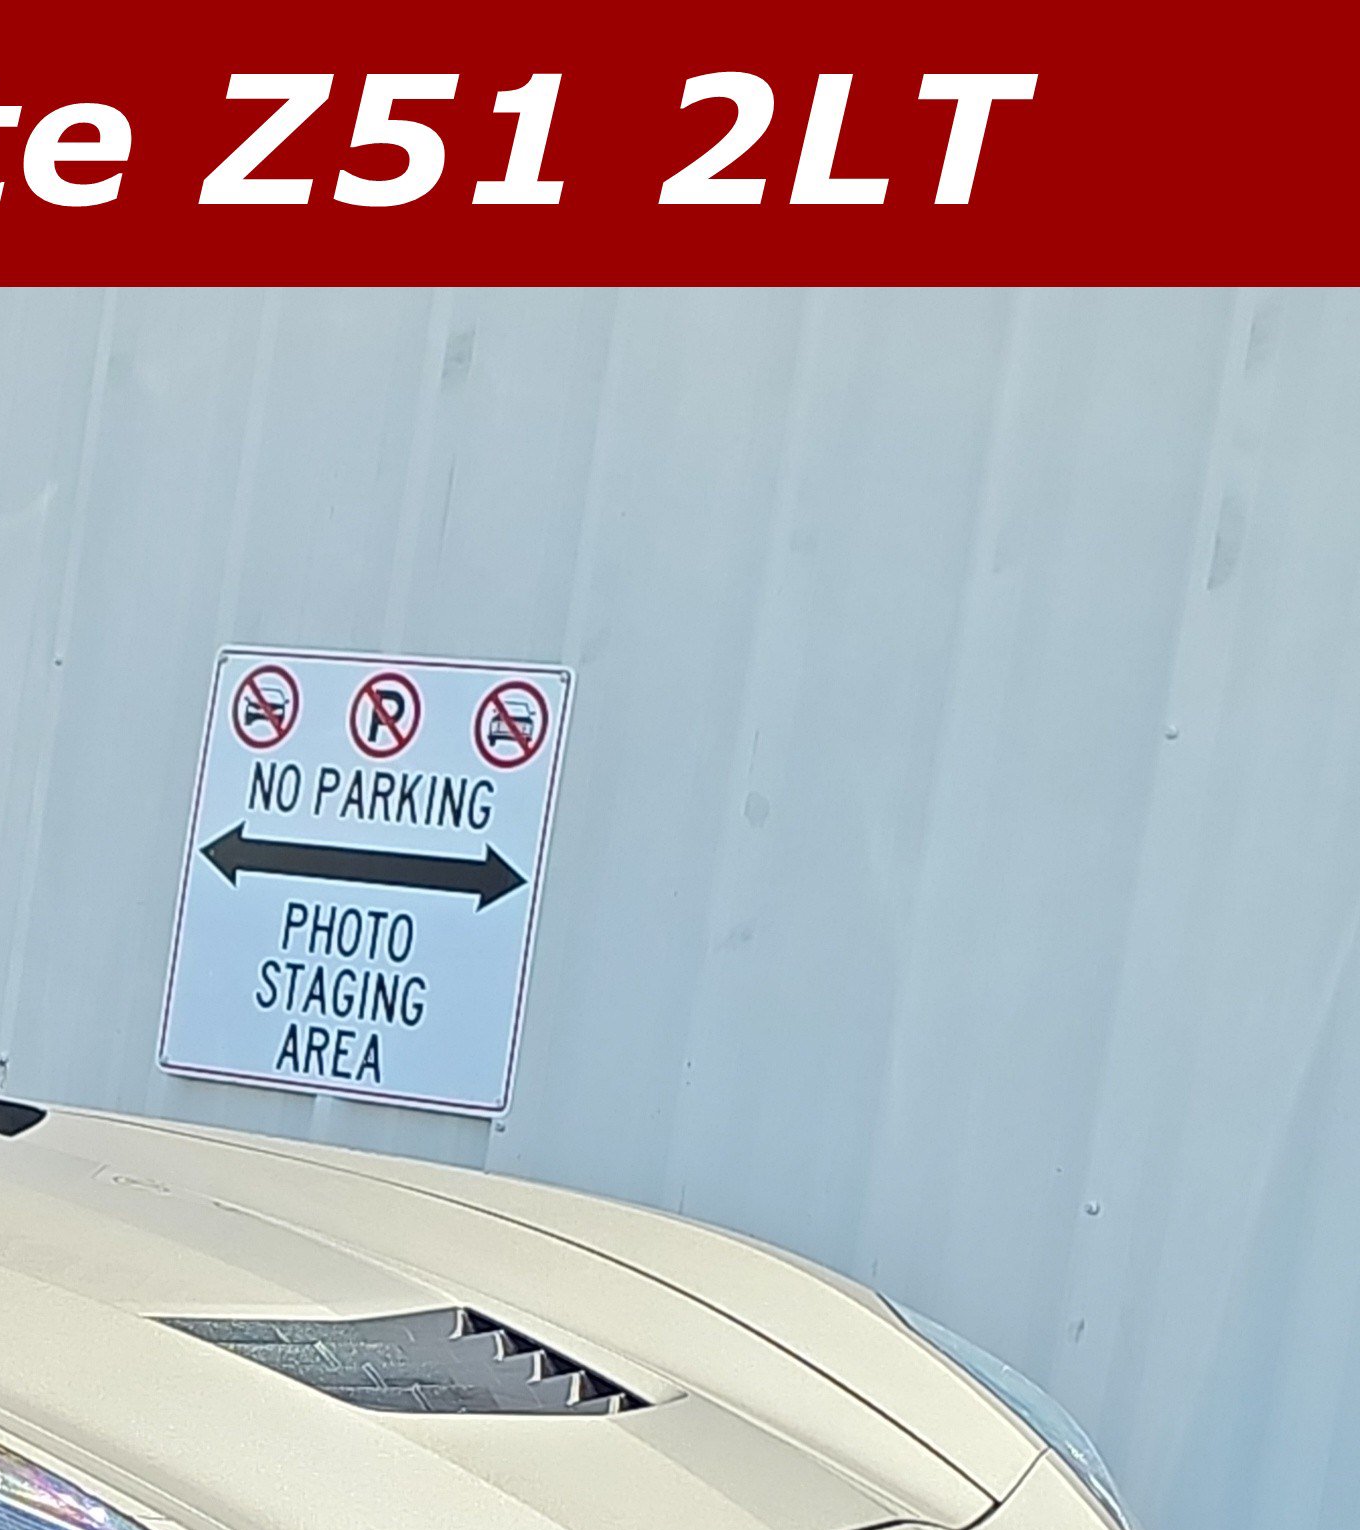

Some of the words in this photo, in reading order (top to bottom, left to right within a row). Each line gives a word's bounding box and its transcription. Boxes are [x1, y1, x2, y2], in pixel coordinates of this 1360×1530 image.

[248, 761, 302, 813] NO
[313, 766, 496, 830] PARKING
[281, 902, 415, 964] PHOTO
[255, 960, 428, 1028] STAGING
[275, 1022, 383, 1085] AREA
